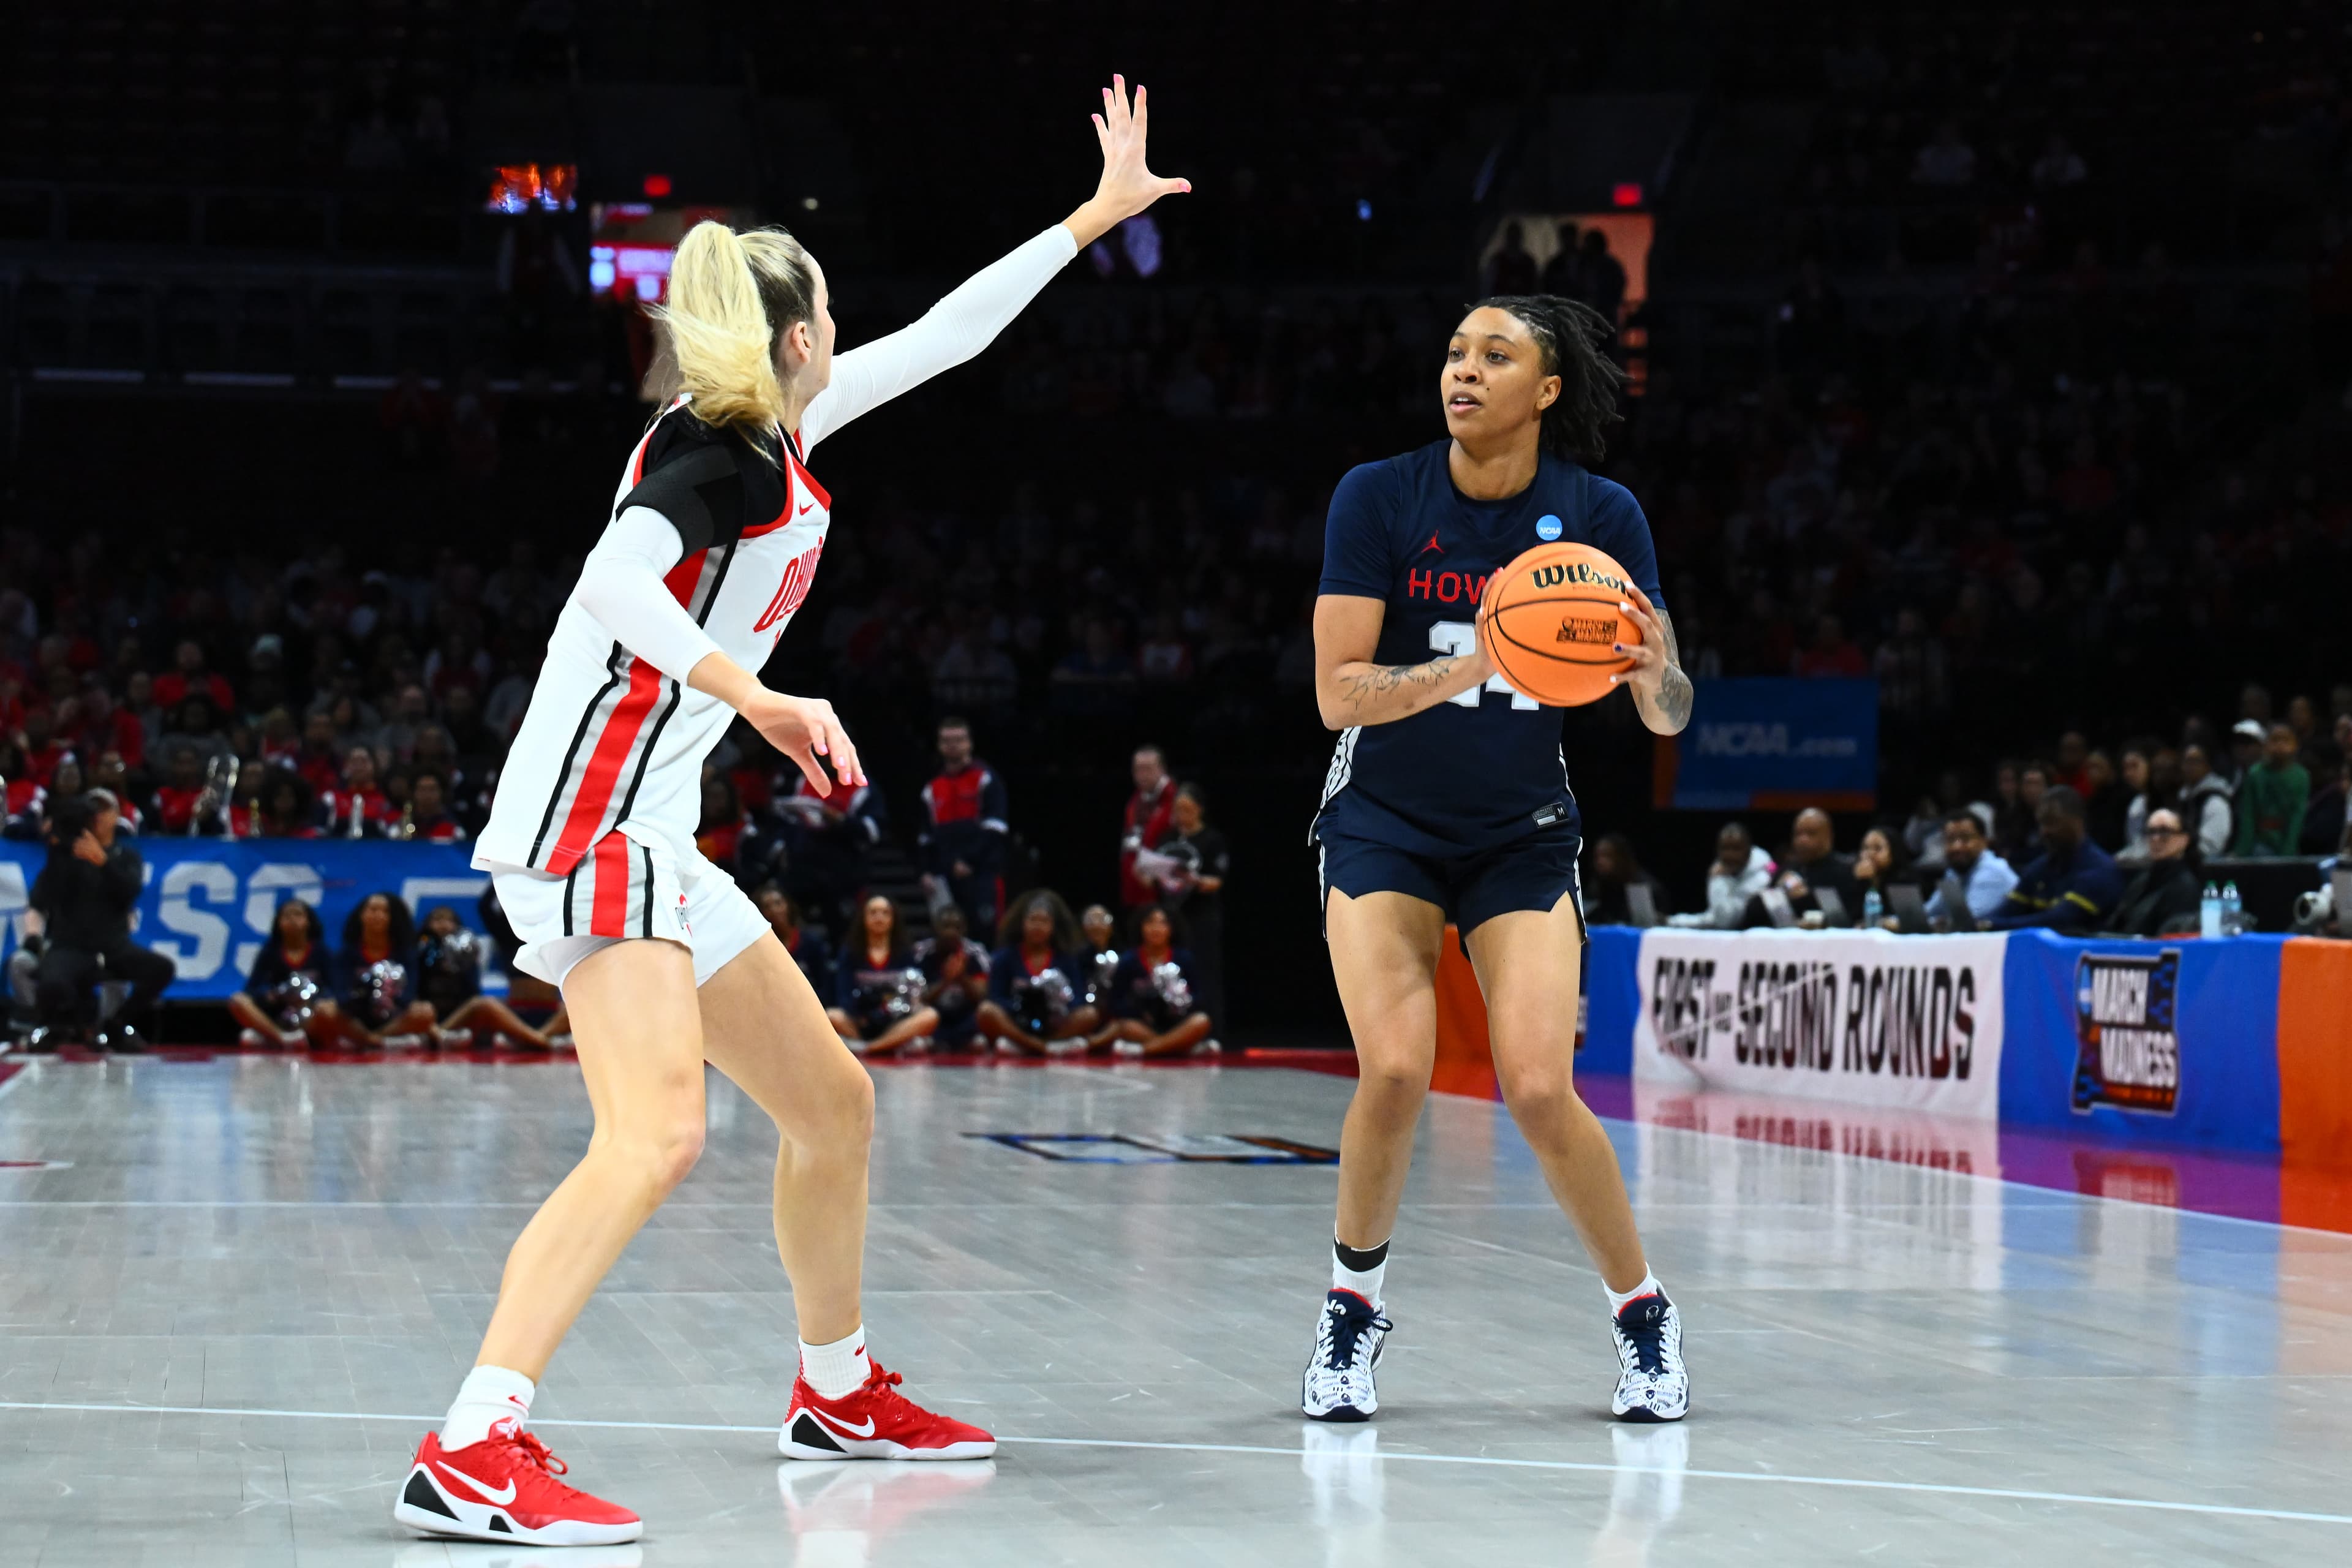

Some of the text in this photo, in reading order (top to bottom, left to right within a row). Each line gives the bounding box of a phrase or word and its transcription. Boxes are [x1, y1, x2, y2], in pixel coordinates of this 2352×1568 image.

[1735, 960, 1836, 1072] SECOND
[1842, 964, 1975, 1080] ROUNDS
[2092, 967, 2148, 1024] MARCH
[2100, 1027, 2176, 1088] MADNESS
